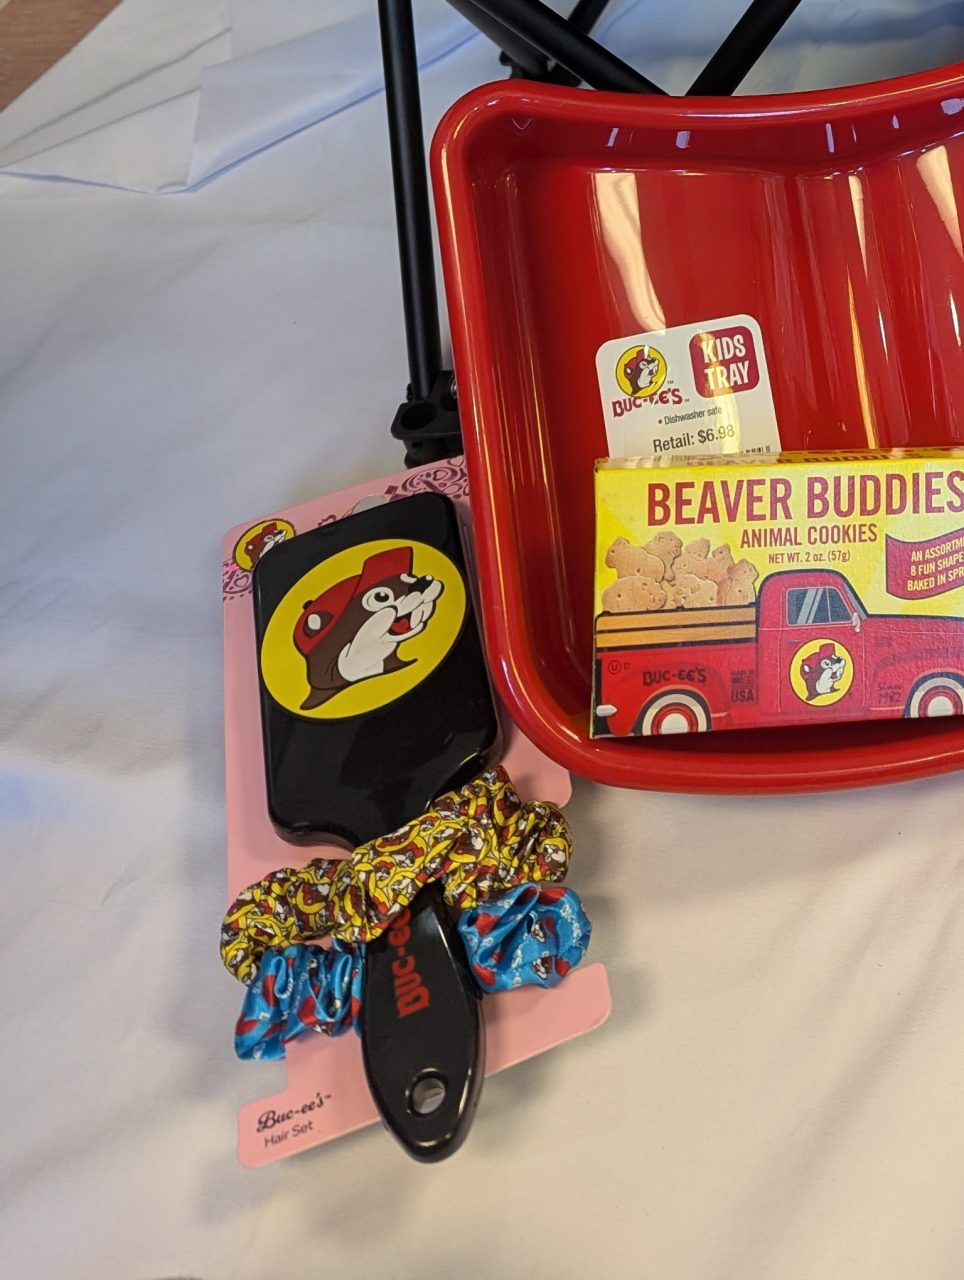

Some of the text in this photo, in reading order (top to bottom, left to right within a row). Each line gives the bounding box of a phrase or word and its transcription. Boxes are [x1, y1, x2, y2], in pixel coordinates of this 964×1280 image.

[702, 334, 747, 363] KIDS
[704, 360, 750, 391] TRAY
[663, 406, 722, 425] Dishwasher safe
[653, 424, 735, 453] Retail: $6.98
[647, 478, 793, 527] BEAVER
[740, 523, 878, 549] ANIMAL COOKIES
[768, 550, 850, 565] NET WT. 2 oz. (57g)
[911, 550, 923, 562] AN
[910, 565, 917, 577] 8
[918, 562, 936, 576] FUN
[907, 577, 935, 592] BAKED
[937, 574, 947, 584] IN
[731, 689, 754, 704] USA
[256, 1091, 324, 1133] Buc-ee's
[264, 1120, 313, 1148] Hair Set
